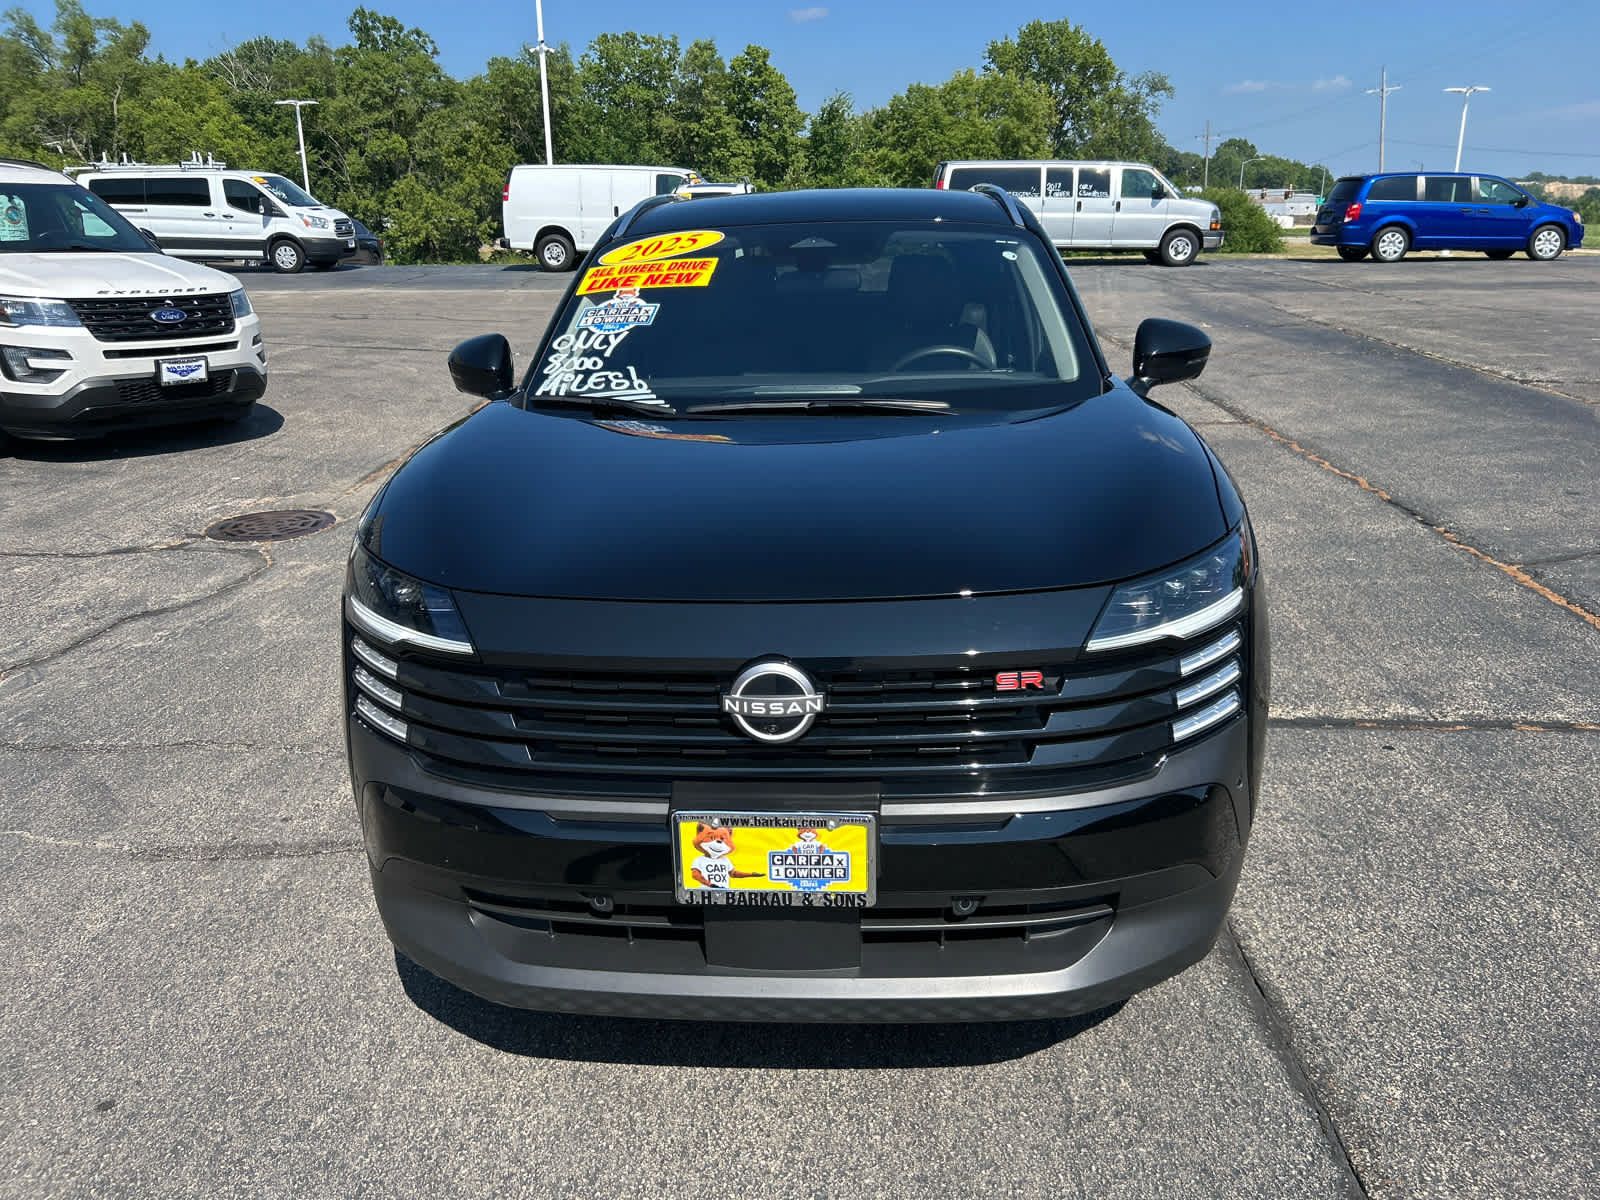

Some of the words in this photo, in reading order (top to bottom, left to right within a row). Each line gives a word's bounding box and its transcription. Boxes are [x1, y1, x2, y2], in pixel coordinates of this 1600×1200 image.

[621, 233, 704, 261] 2025
[589, 267, 615, 279] ALL
[617, 263, 664, 275] WHEEL
[666, 260, 712, 271] DRIVE
[585, 275, 640, 292] LIKE
[642, 271, 703, 287] NEW
[96, 287, 208, 295] EXPLORER
[160, 310, 181, 320] Ford
[586, 308, 651, 317] CARFAX
[593, 315, 649, 324] OWNER
[552, 330, 629, 357] ONLY
[996, 672, 1043, 691] SR
[725, 698, 823, 715] NISSAN
[720, 817, 827, 828] www.barkau.com
[773, 856, 844, 866] CARFAX
[706, 864, 727, 873] CAR
[786, 868, 845, 878] OWNER
[708, 874, 727, 882] FOX
[685, 891, 718, 905] J.H.
[726, 892, 793, 907] BARKAU
[802, 893, 814, 907] &
[823, 893, 867, 907] SONS
